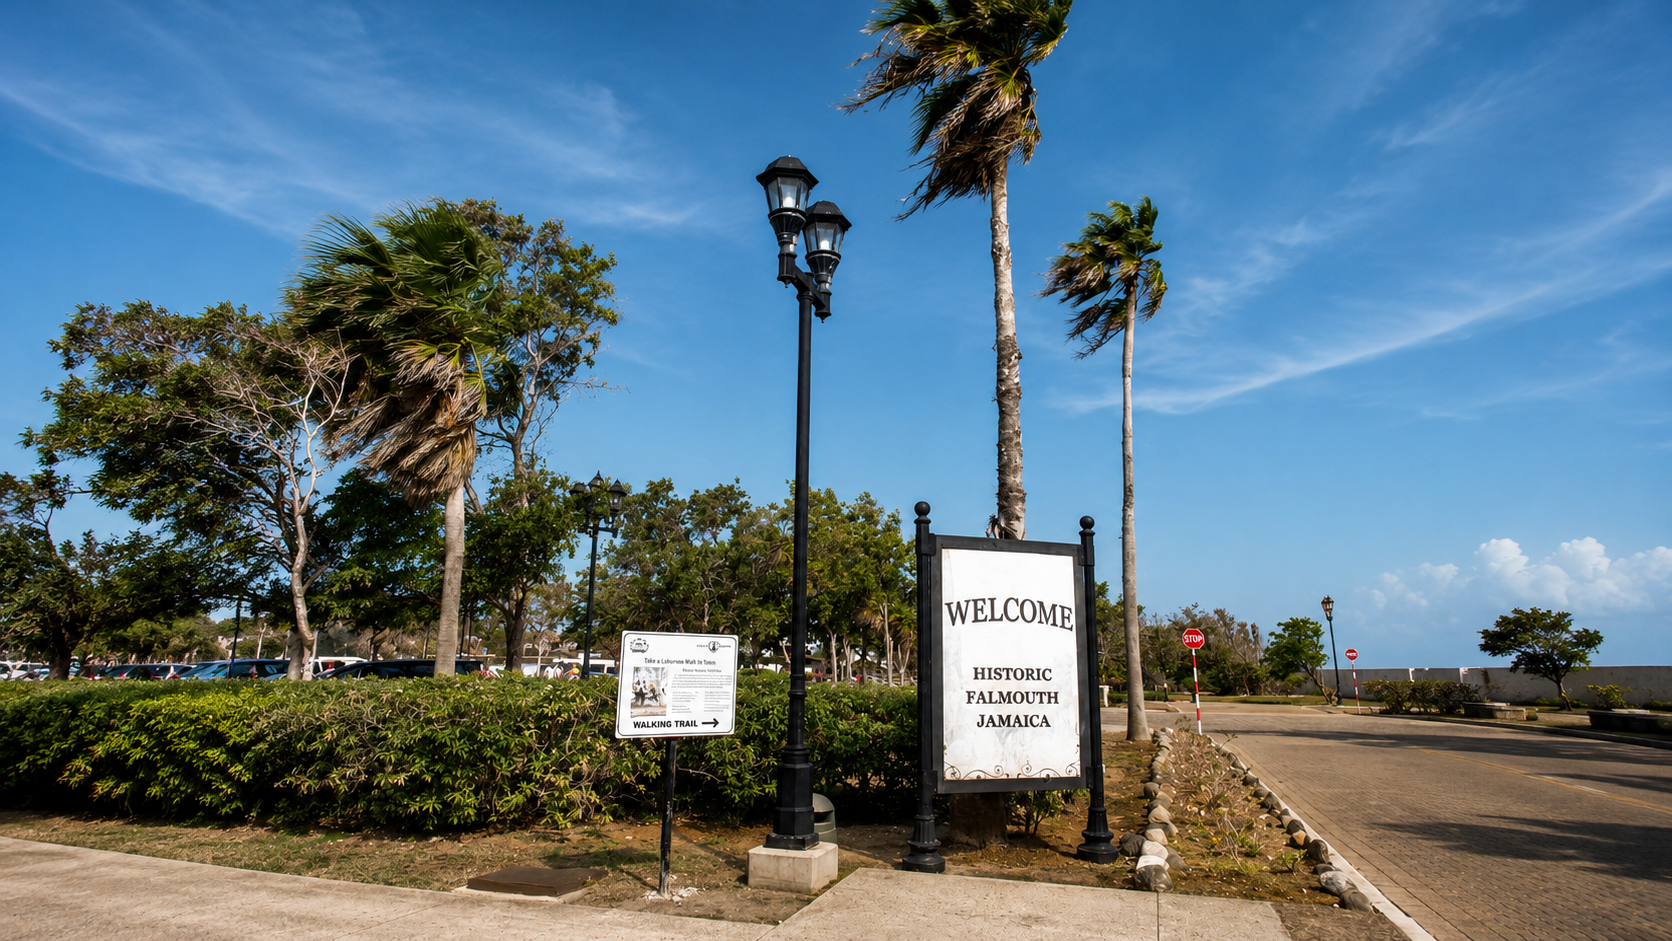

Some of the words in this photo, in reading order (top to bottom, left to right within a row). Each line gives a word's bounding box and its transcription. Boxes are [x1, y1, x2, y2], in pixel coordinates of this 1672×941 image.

[945, 597, 1074, 632] WELCOME
[1183, 634, 1203, 644] STOP
[973, 667, 1052, 681] HISTORIC
[966, 691, 1059, 705] FALMOUTH
[633, 720, 672, 729] WALKING
[674, 720, 698, 728] TRAIL
[977, 714, 1051, 728] JAMAICA
